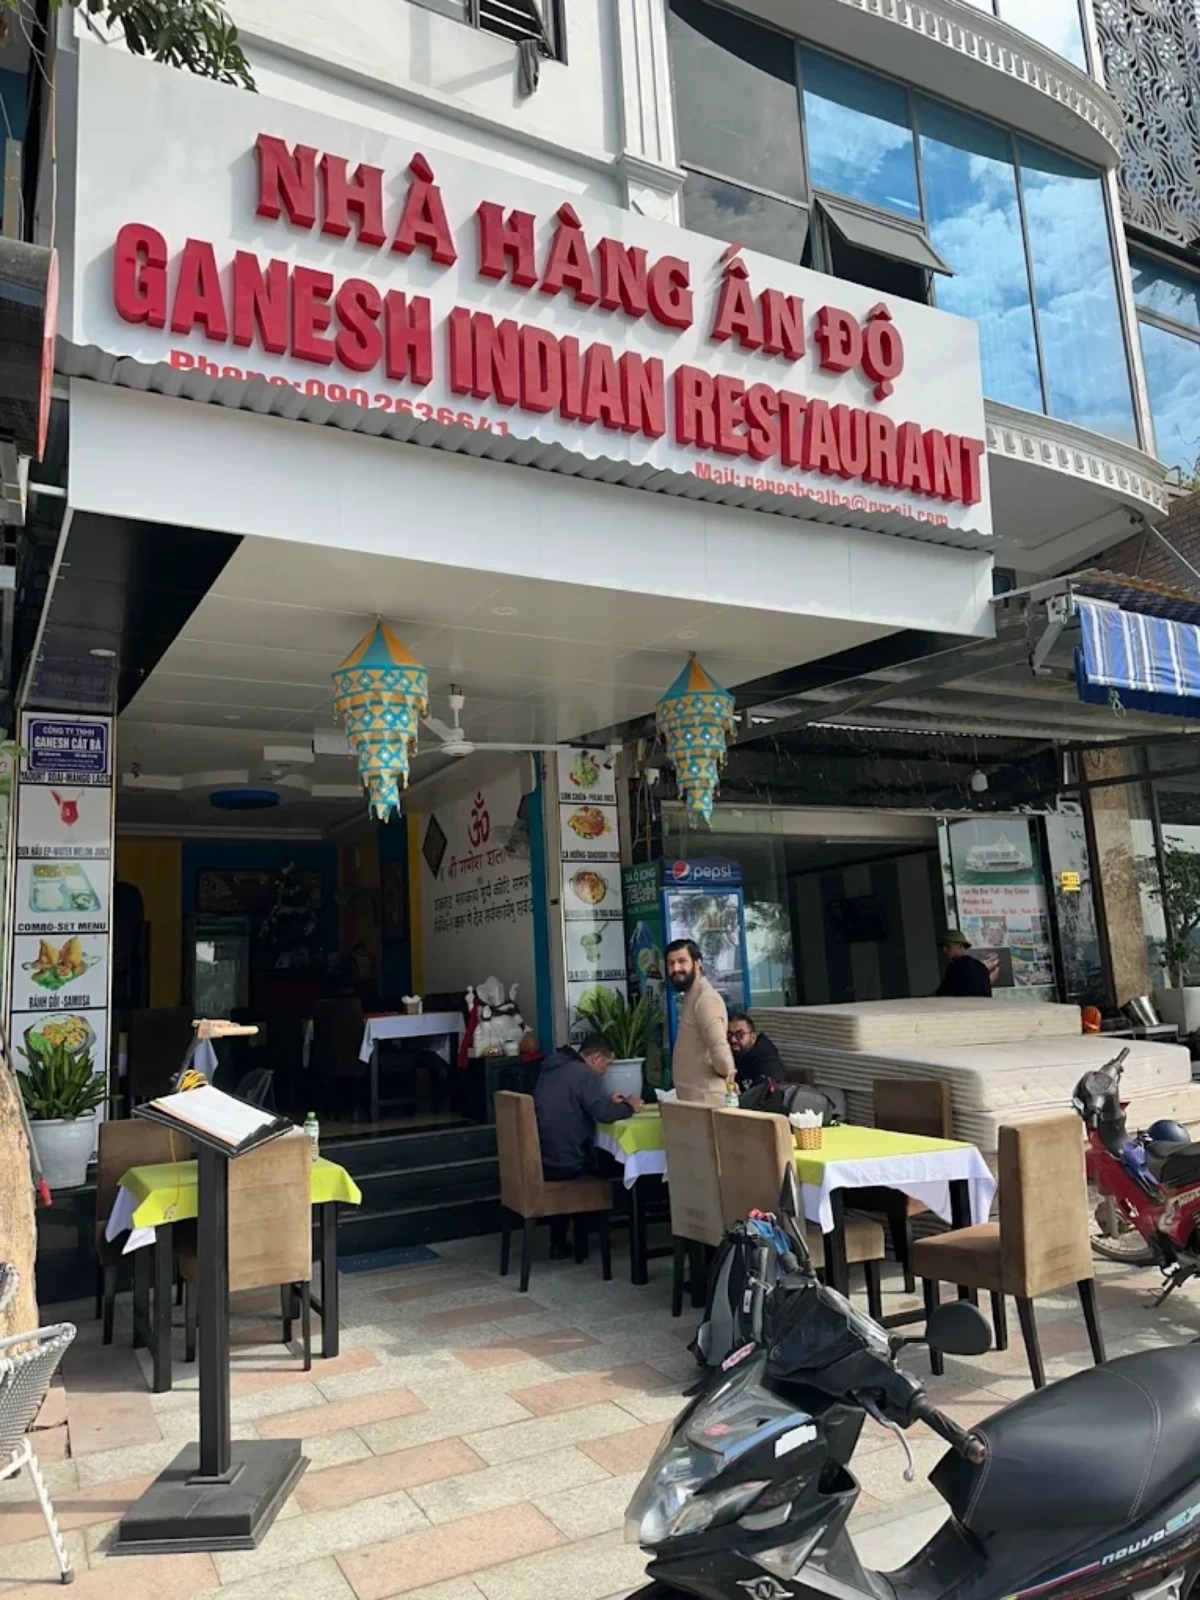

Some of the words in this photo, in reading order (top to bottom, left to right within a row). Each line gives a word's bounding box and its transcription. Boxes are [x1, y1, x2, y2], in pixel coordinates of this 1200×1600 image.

[255, 132, 457, 266] NHÀ
[476, 201, 693, 330] HÀNG
[710, 240, 805, 361] ẤN
[814, 301, 904, 401] ĐỘ
[114, 223, 431, 386] GANESH
[449, 306, 665, 440] INDIAN
[673, 363, 984, 506] RESTAURANT
[695, 461, 740, 486] Mail:
[34, 736, 70, 748] GANESH
[694, 864, 731, 880] pepsi
[18, 922, 75, 931] COMBO-SET
[78, 922, 106, 930] MENU
